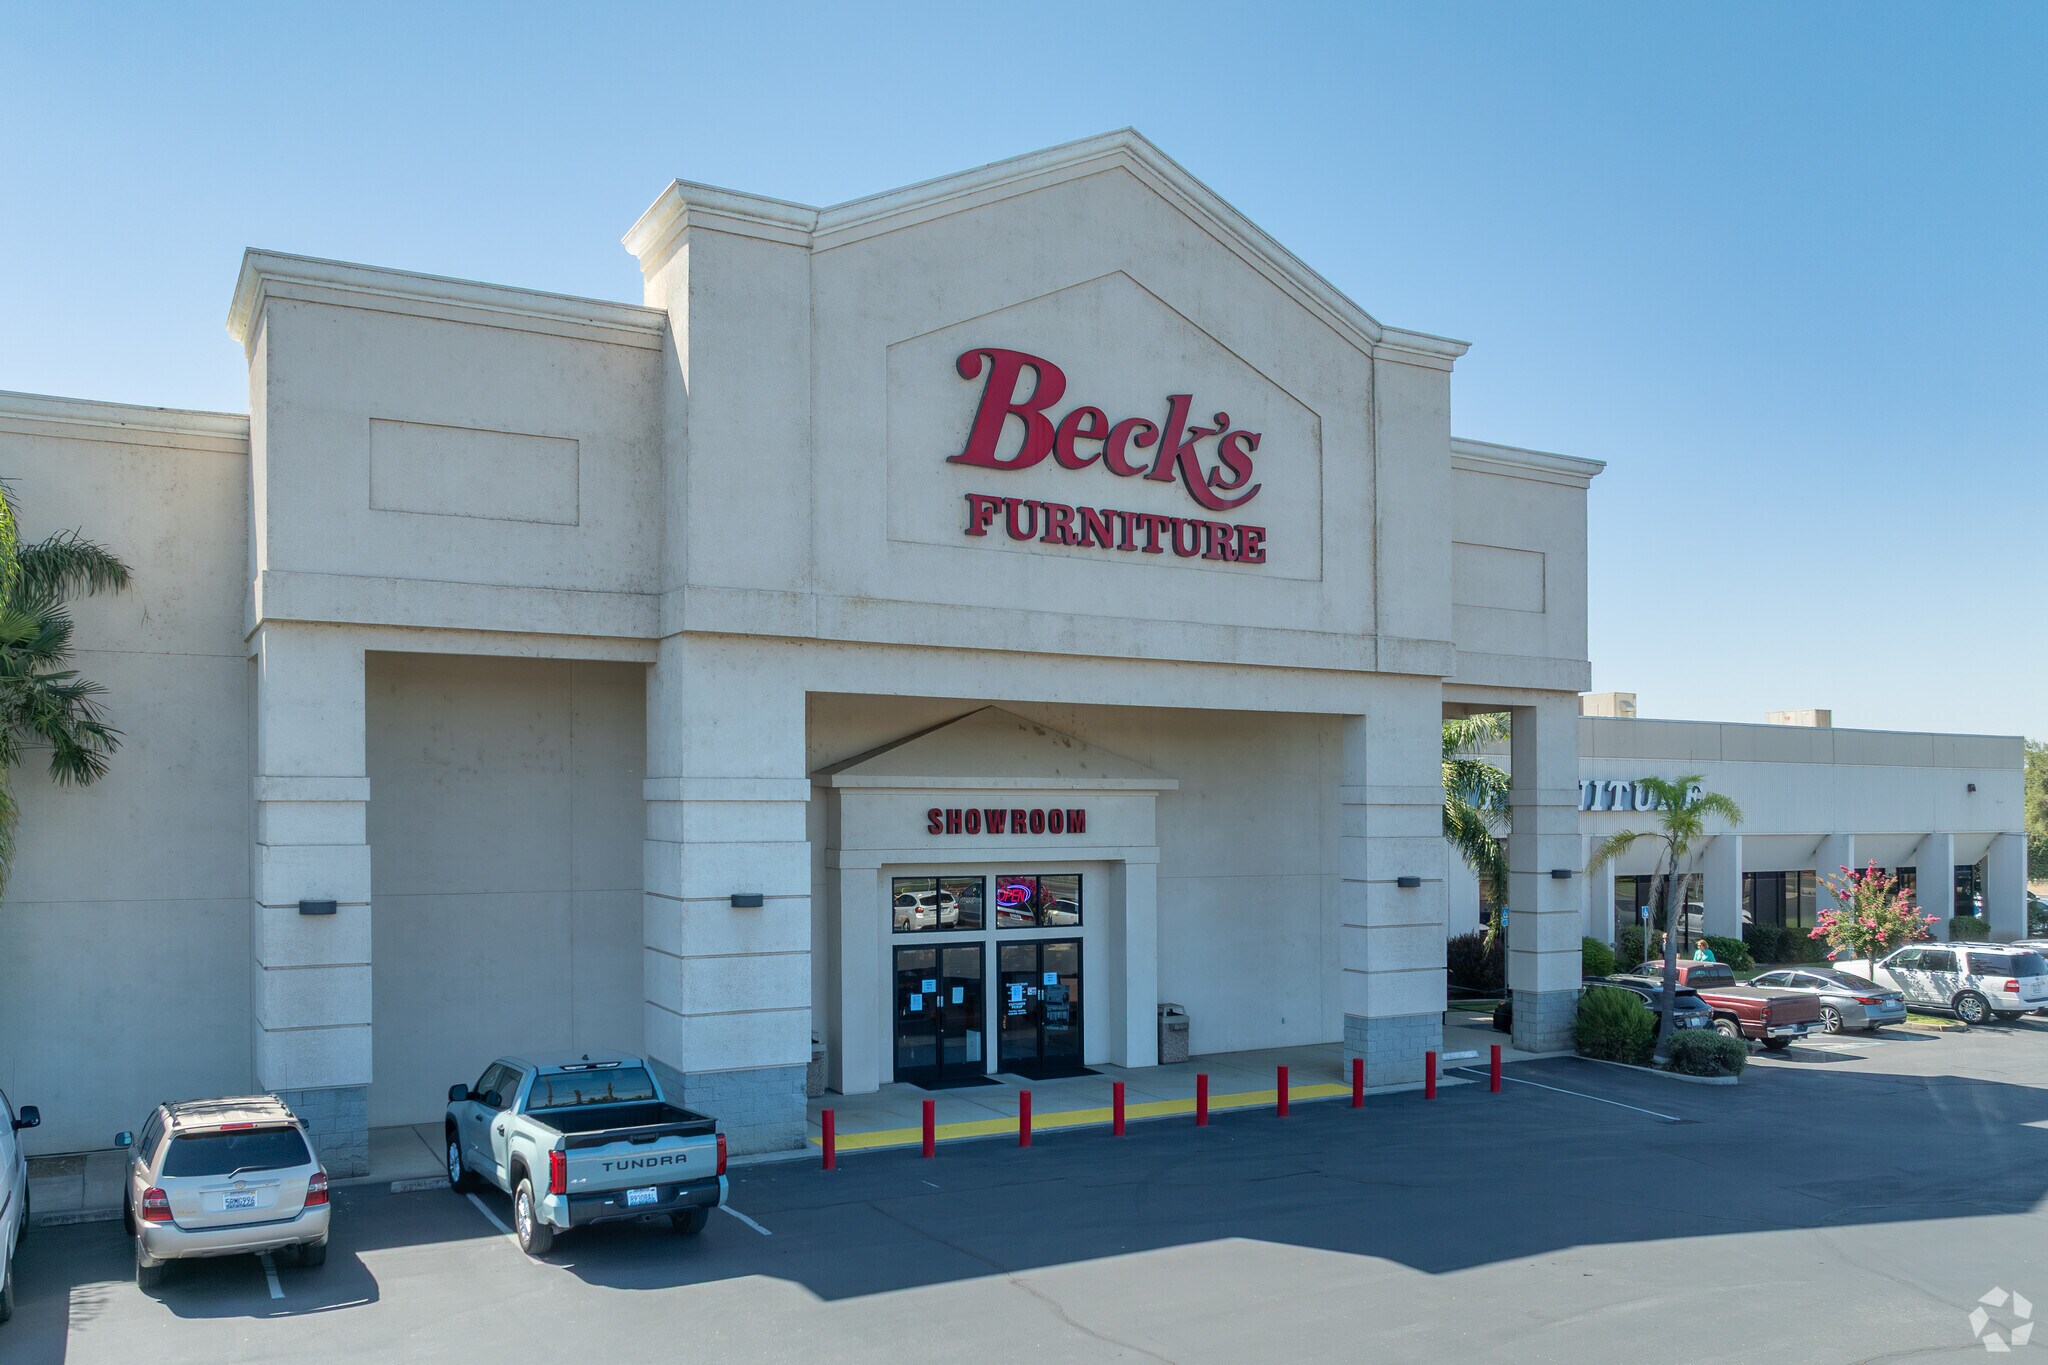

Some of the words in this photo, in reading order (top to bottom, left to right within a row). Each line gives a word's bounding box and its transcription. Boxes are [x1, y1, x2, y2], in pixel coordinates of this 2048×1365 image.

[946, 347, 1262, 511] Beck's
[964, 493, 1266, 563] FURNITURE
[927, 807, 1086, 835] SHOWROOM
[997, 888, 1026, 902] OPEN
[602, 1154, 687, 1172] TUNDRA
